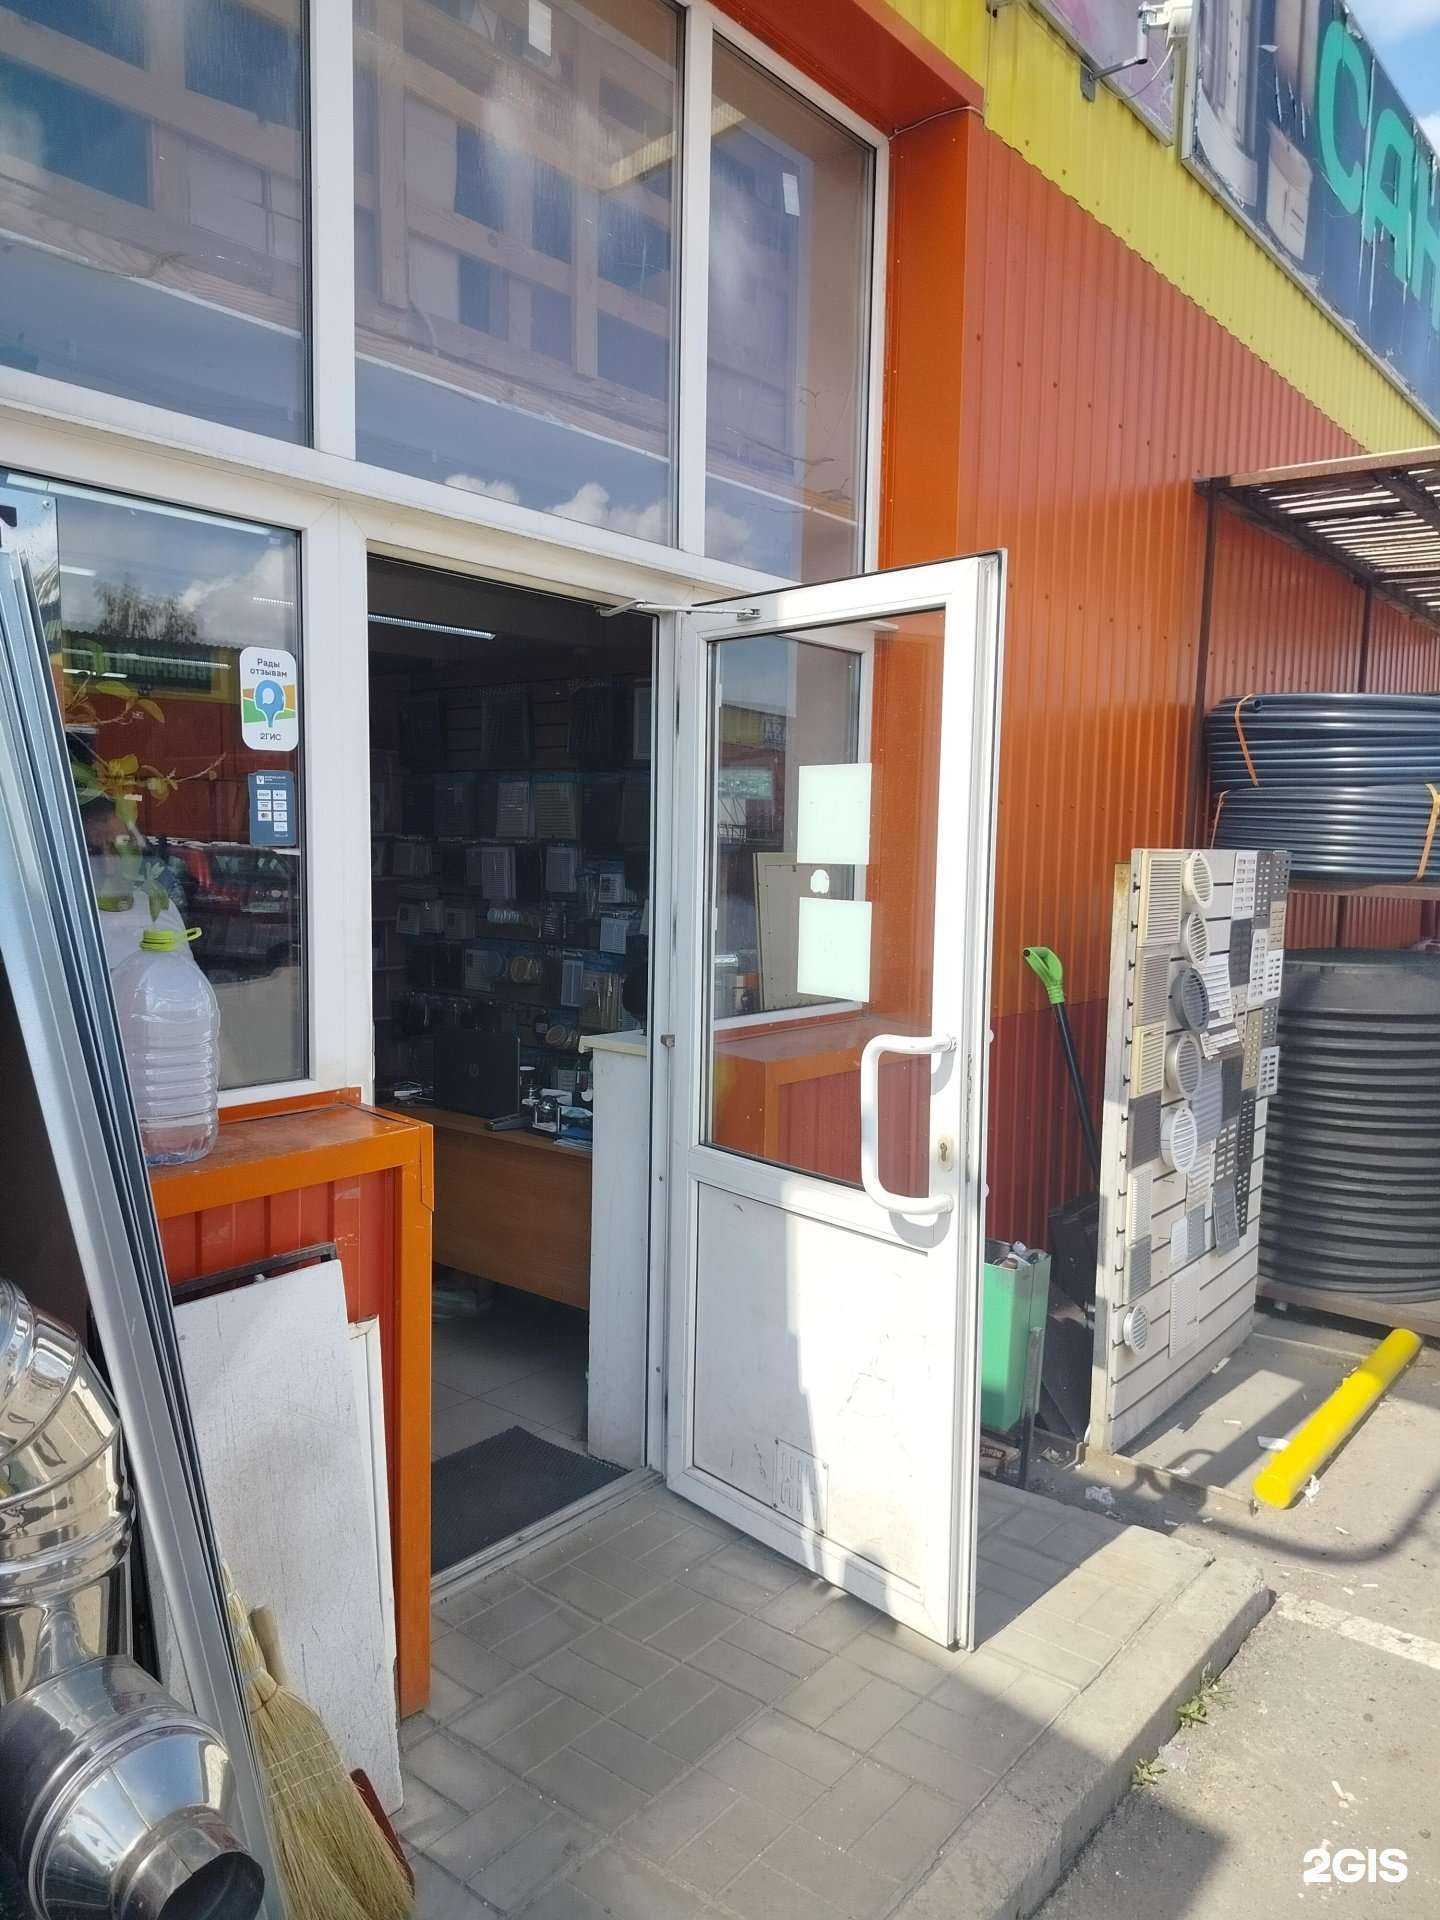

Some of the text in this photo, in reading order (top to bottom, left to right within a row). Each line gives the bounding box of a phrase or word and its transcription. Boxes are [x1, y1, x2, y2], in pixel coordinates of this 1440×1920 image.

[257, 658, 280, 669] Рады
[250, 668, 288, 678] отзывам
[260, 732, 282, 741] 2ГИС
